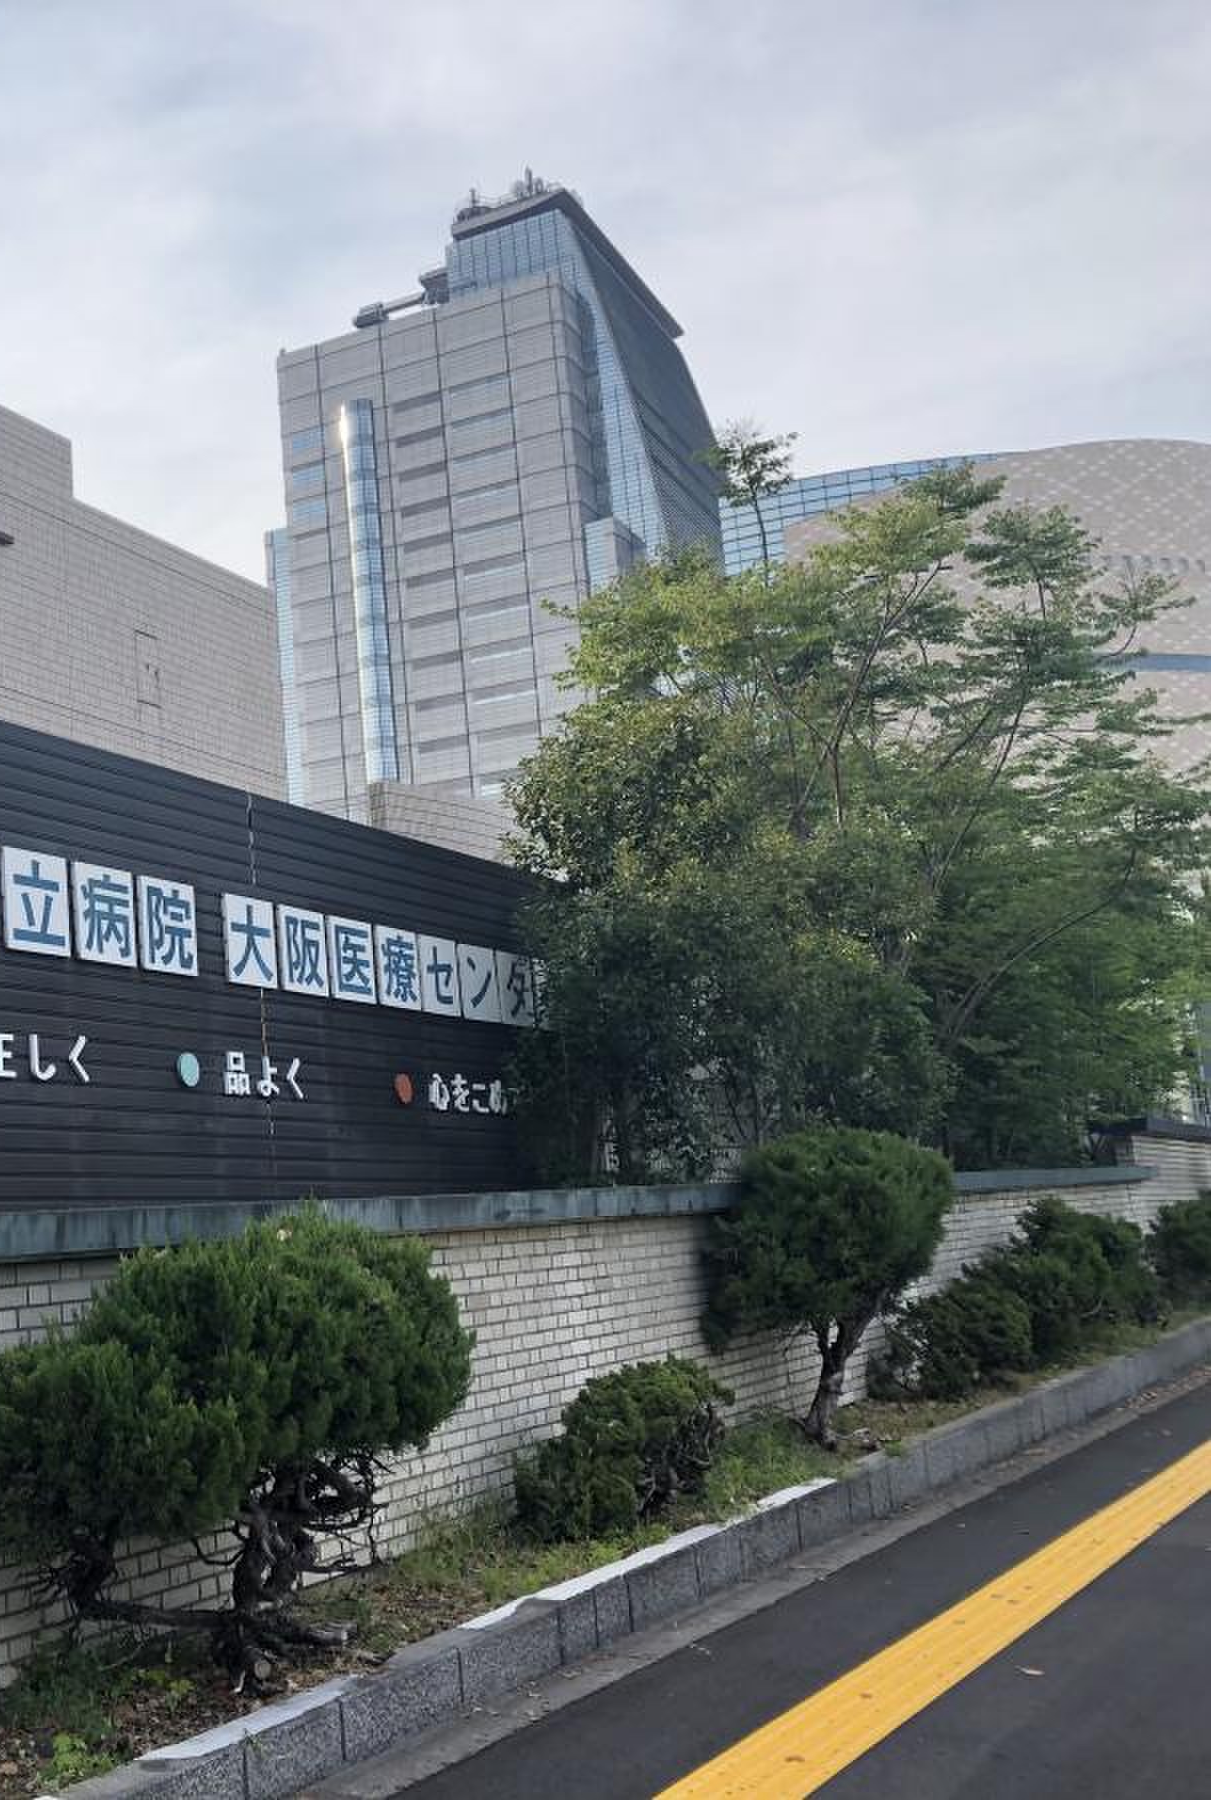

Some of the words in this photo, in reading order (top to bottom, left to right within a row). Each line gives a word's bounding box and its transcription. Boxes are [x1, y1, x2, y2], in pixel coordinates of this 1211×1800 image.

[222, 1050, 306, 1100] 品よく
[427, 1072, 518, 1116] 心をこめ
